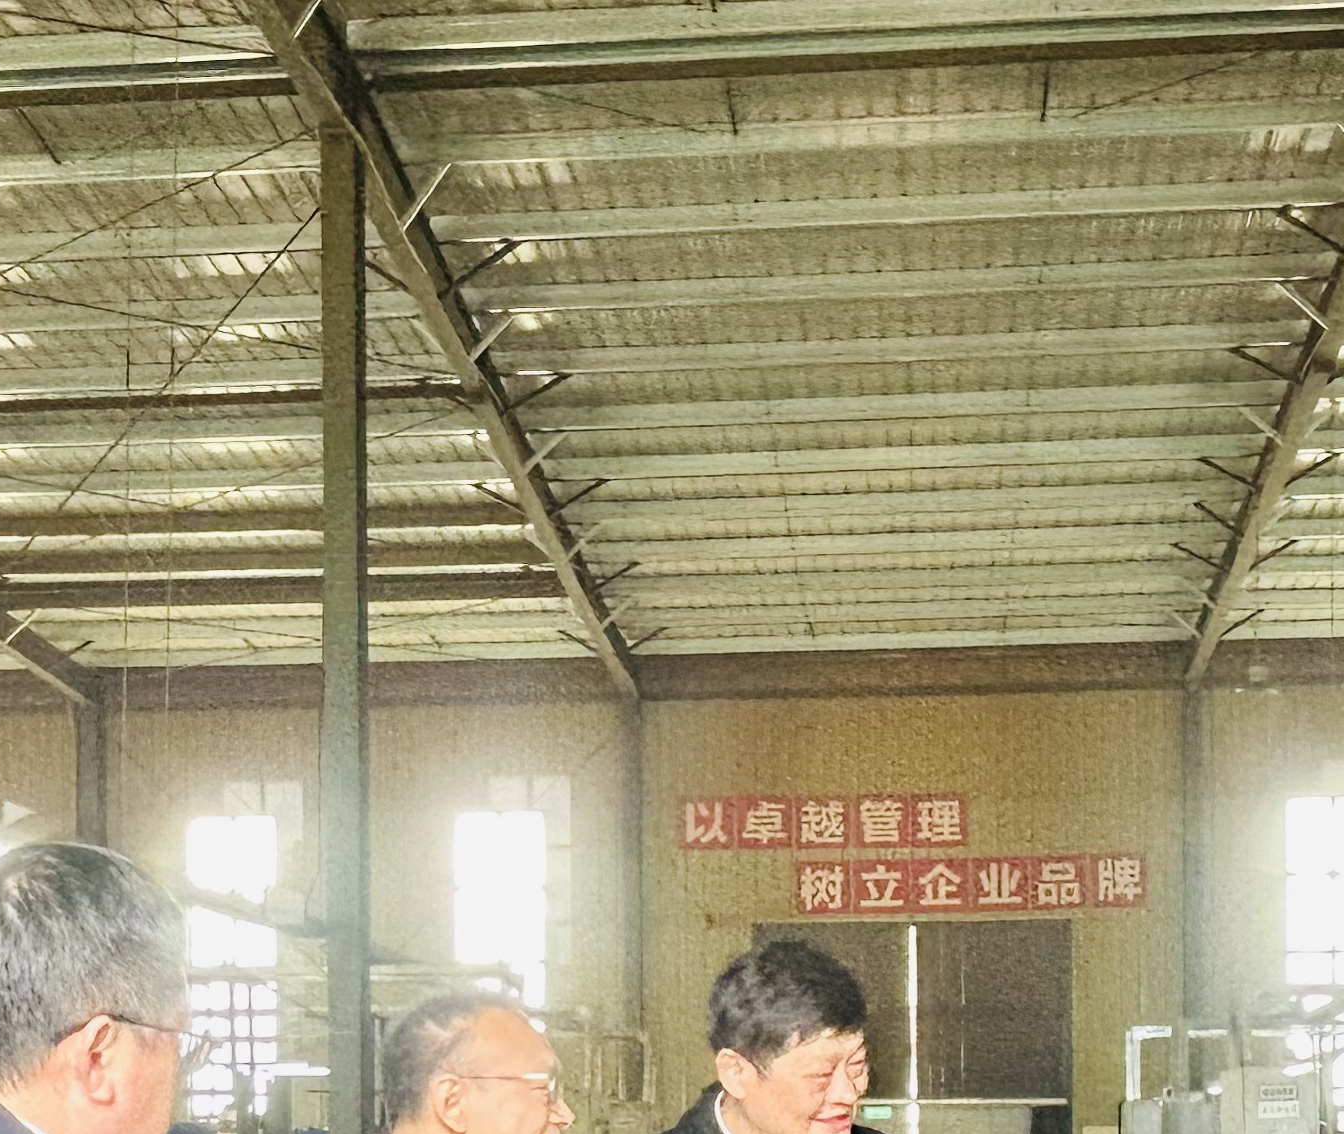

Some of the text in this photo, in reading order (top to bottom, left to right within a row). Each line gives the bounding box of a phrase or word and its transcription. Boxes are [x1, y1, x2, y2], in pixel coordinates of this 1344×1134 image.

[683, 799, 963, 845] 以卓越管理
[800, 858, 1143, 911] 树立企业品牌
